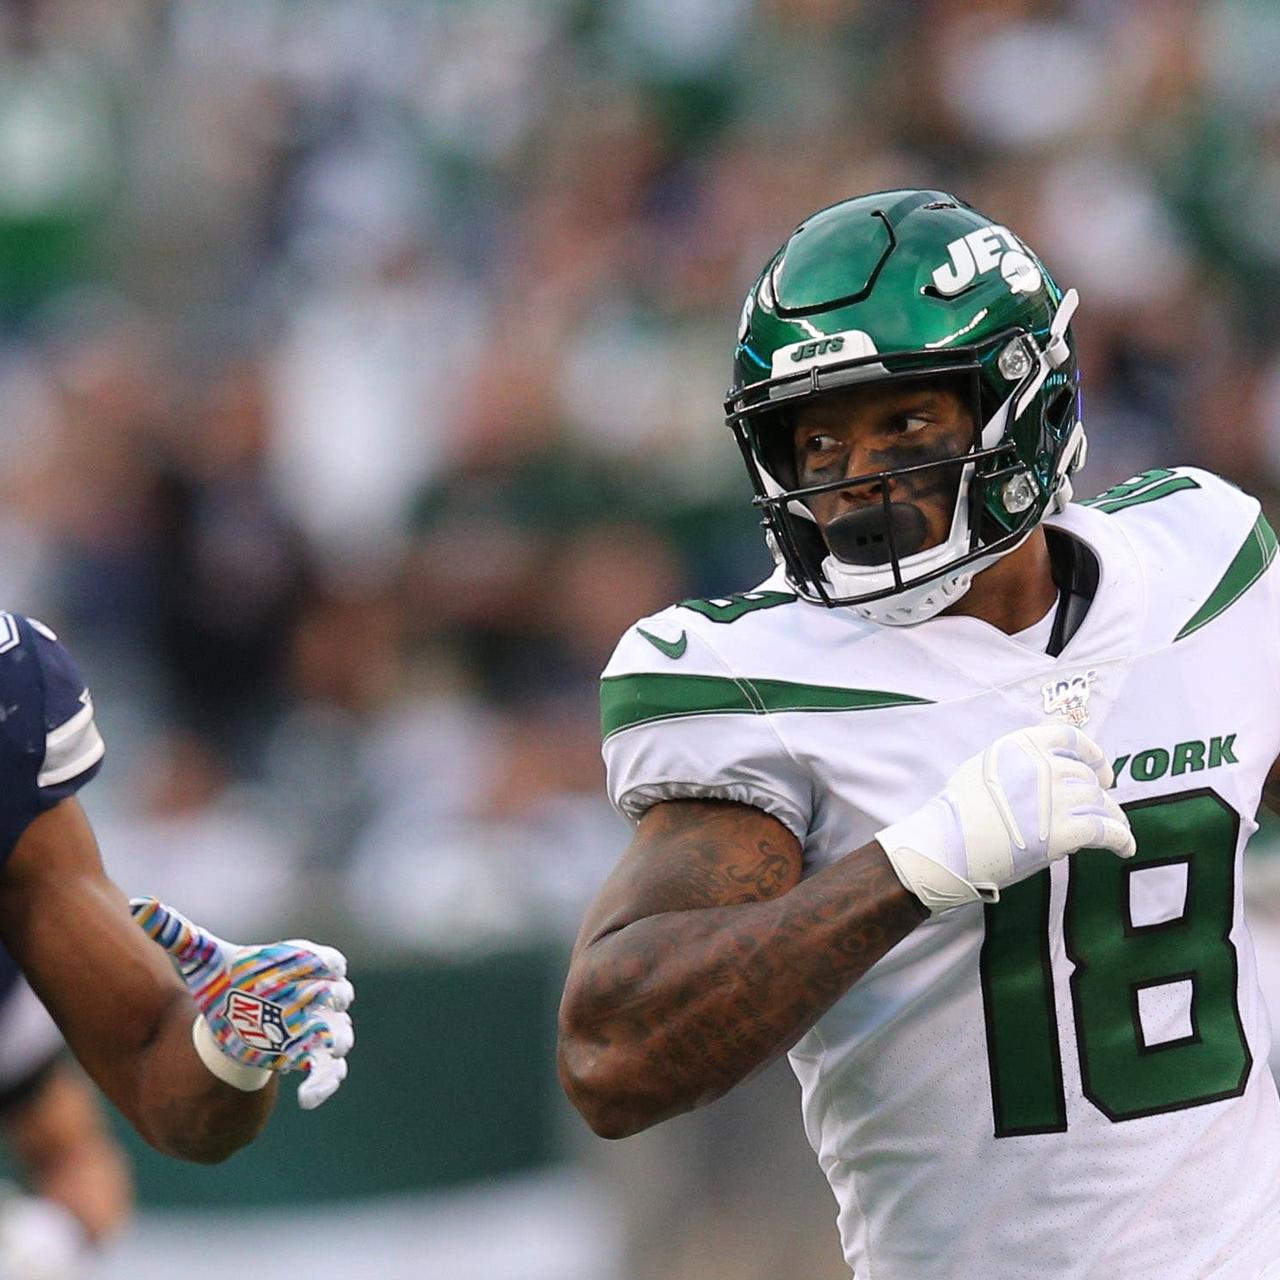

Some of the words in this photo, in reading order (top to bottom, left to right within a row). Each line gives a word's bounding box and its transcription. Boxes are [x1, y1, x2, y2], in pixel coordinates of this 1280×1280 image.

[790, 336, 846, 362] JETS
[979, 786, 1254, 1139] 18
[230, 997, 269, 1044] NFL
